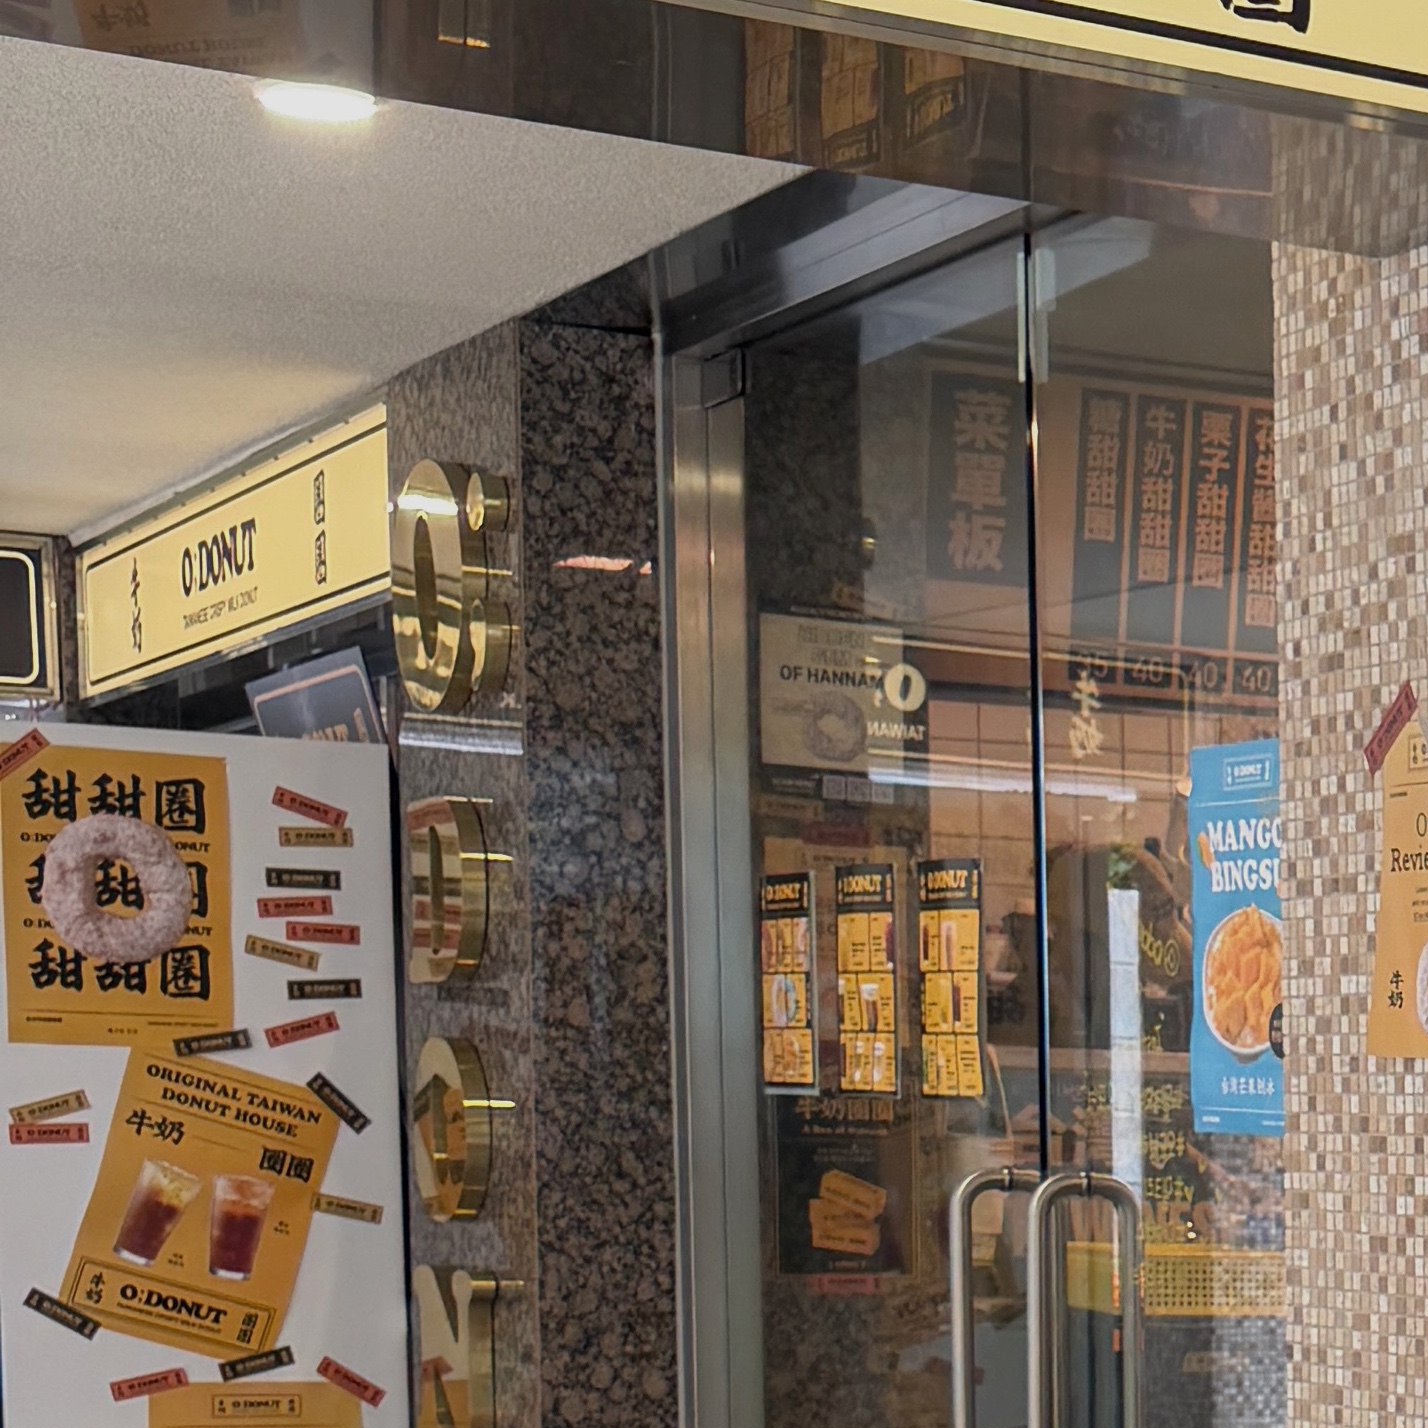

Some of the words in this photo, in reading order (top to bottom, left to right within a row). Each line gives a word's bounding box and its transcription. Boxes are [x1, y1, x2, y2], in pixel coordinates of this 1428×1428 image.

[147, 1064, 243, 1102] ORIGINAL
[247, 1091, 322, 1125] TAIWAN
[161, 1087, 231, 1118] DONUT
[235, 1107, 298, 1138] HOUSE
[125, 1108, 185, 1145] 牛奶
